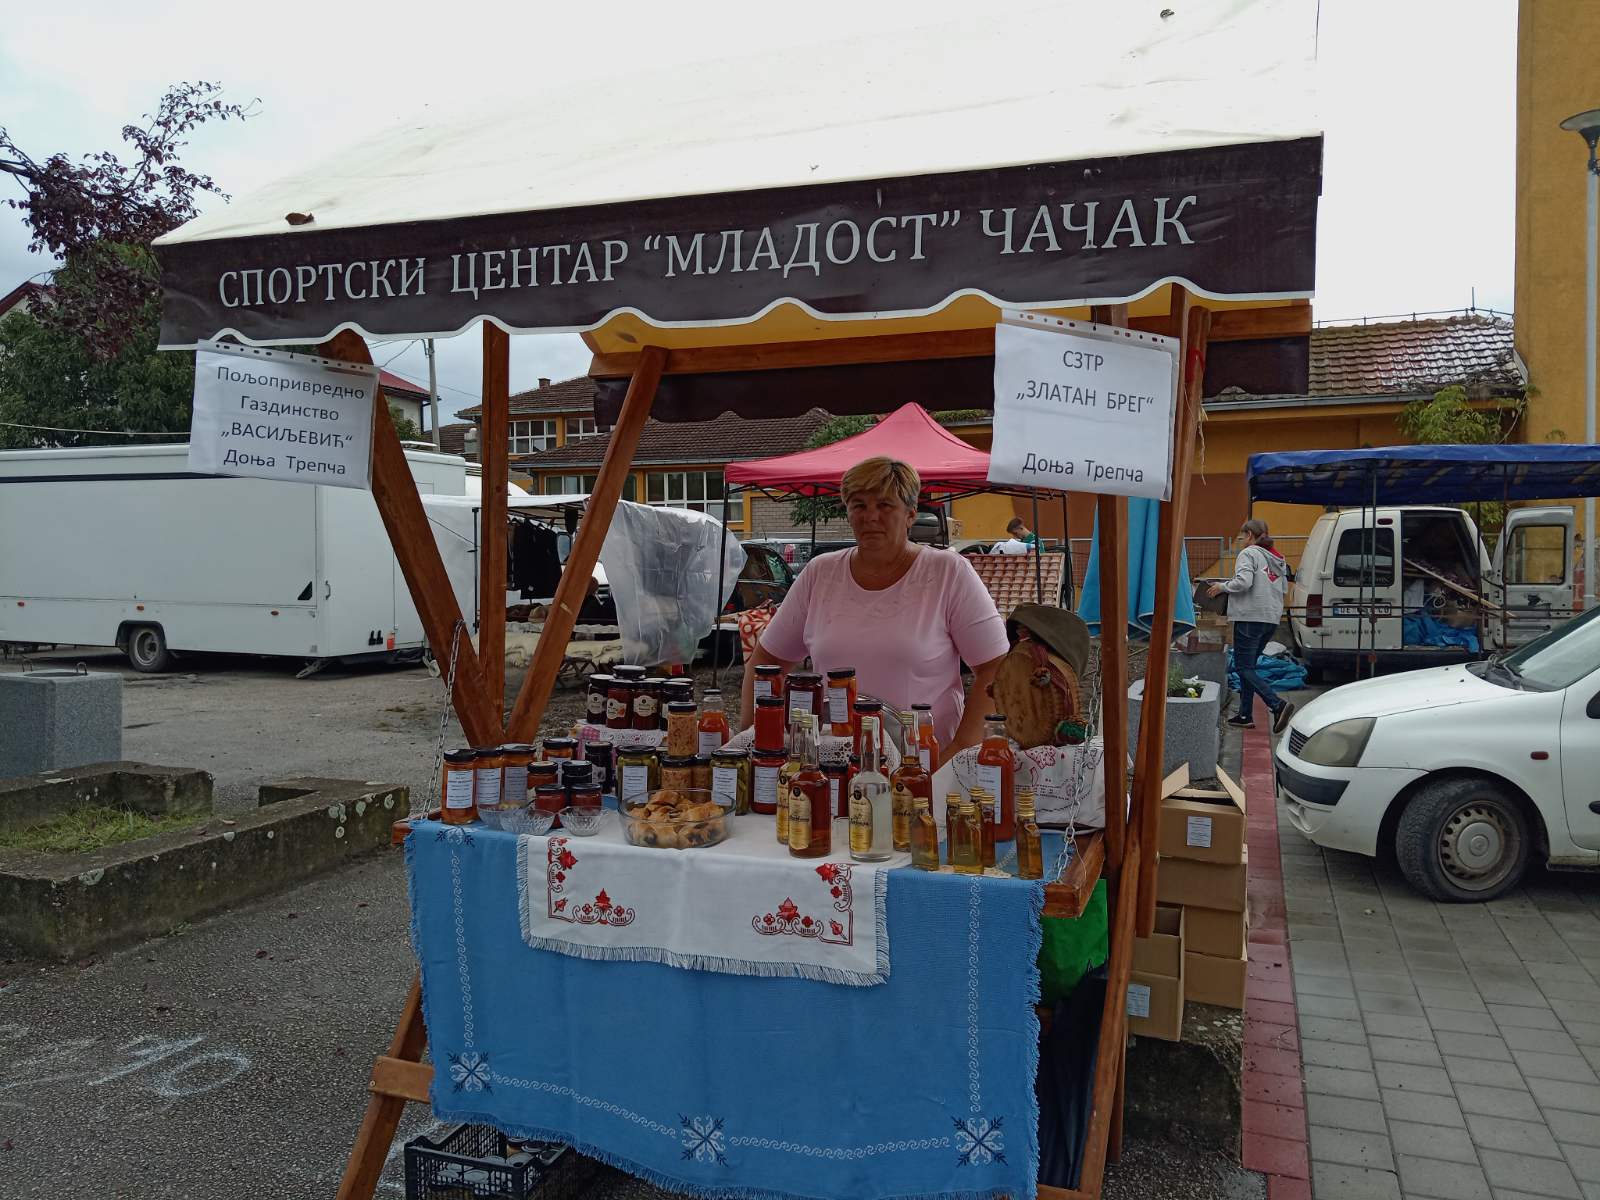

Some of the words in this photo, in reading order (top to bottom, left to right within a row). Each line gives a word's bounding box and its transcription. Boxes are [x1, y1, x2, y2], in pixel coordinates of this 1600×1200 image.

[219, 257, 427, 307] СПОРТСКИ
[450, 239, 629, 300] ЦЕНТАР
[643, 209, 961, 278] “МЛАДОСТ”
[979, 194, 1198, 255] ЧАЧАК
[1062, 350, 1104, 372] СЗТР
[217, 366, 365, 400] Пољопривредно
[1016, 380, 1096, 407] „ЗЛАТАН
[1106, 392, 1154, 413] БРЕГ“
[240, 395, 339, 421] Газдинство
[221, 422, 353, 449] „ВАСИЉЕВИЋ“
[223, 449, 275, 467] Доња
[285, 455, 346, 475] Трепча
[1022, 453, 1074, 475] Доња
[1084, 460, 1144, 483] Трепча
